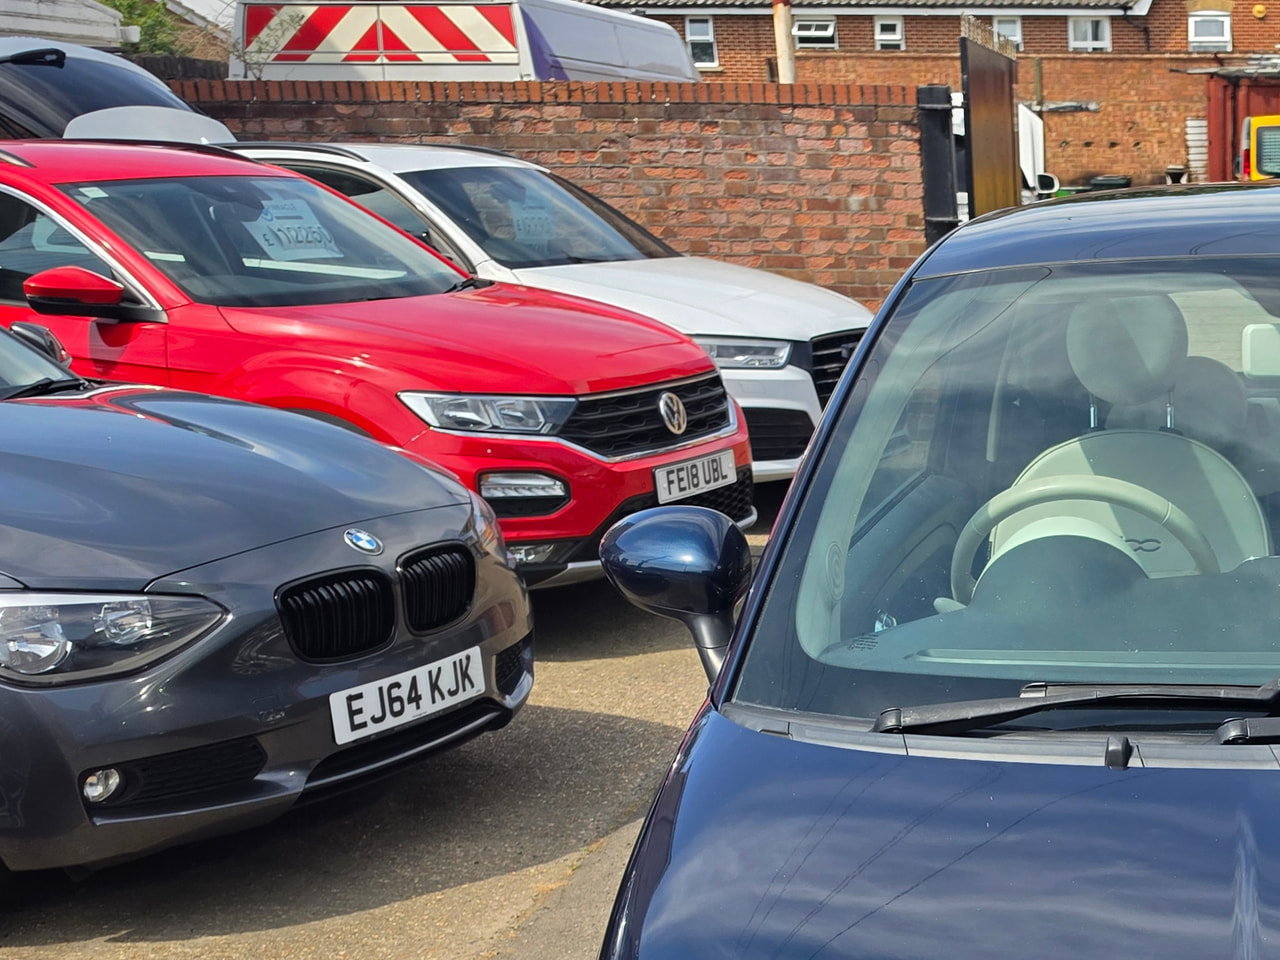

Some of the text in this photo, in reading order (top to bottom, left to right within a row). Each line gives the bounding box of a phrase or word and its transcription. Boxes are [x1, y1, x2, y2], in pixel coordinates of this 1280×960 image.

[666, 457, 728, 495] FE18 UBL
[346, 654, 475, 732] EJ64 KJK
